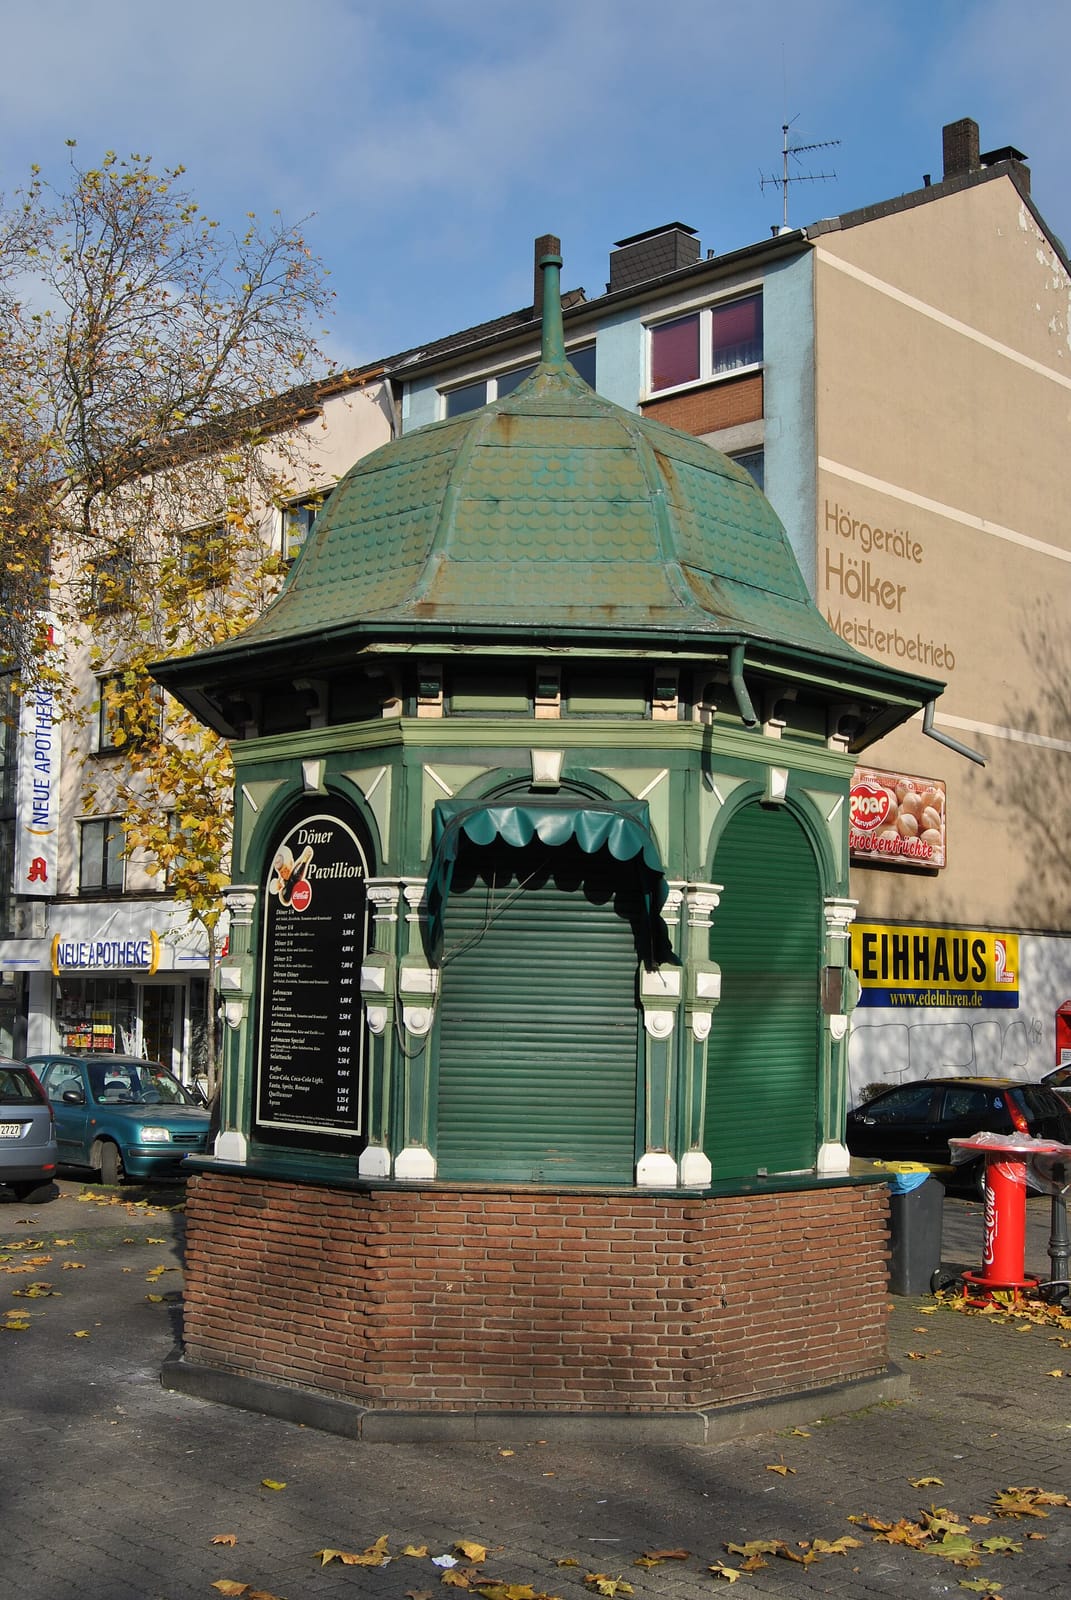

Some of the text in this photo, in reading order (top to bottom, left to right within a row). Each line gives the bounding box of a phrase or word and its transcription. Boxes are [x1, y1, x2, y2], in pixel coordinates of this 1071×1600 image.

[826, 500, 923, 564] Hörgeräte
[826, 548, 906, 613] Hölker
[828, 608, 956, 671] Meisterbetrieb
[32, 778, 50, 825] NEUE
[298, 829, 334, 844] Döner
[308, 862, 362, 880] Pavillion
[57, 941, 148, 966] NEUE APOTHEKE
[890, 990, 983, 1006] www.edeluhren.de
[1, 1126, 19, 1134] 2727
